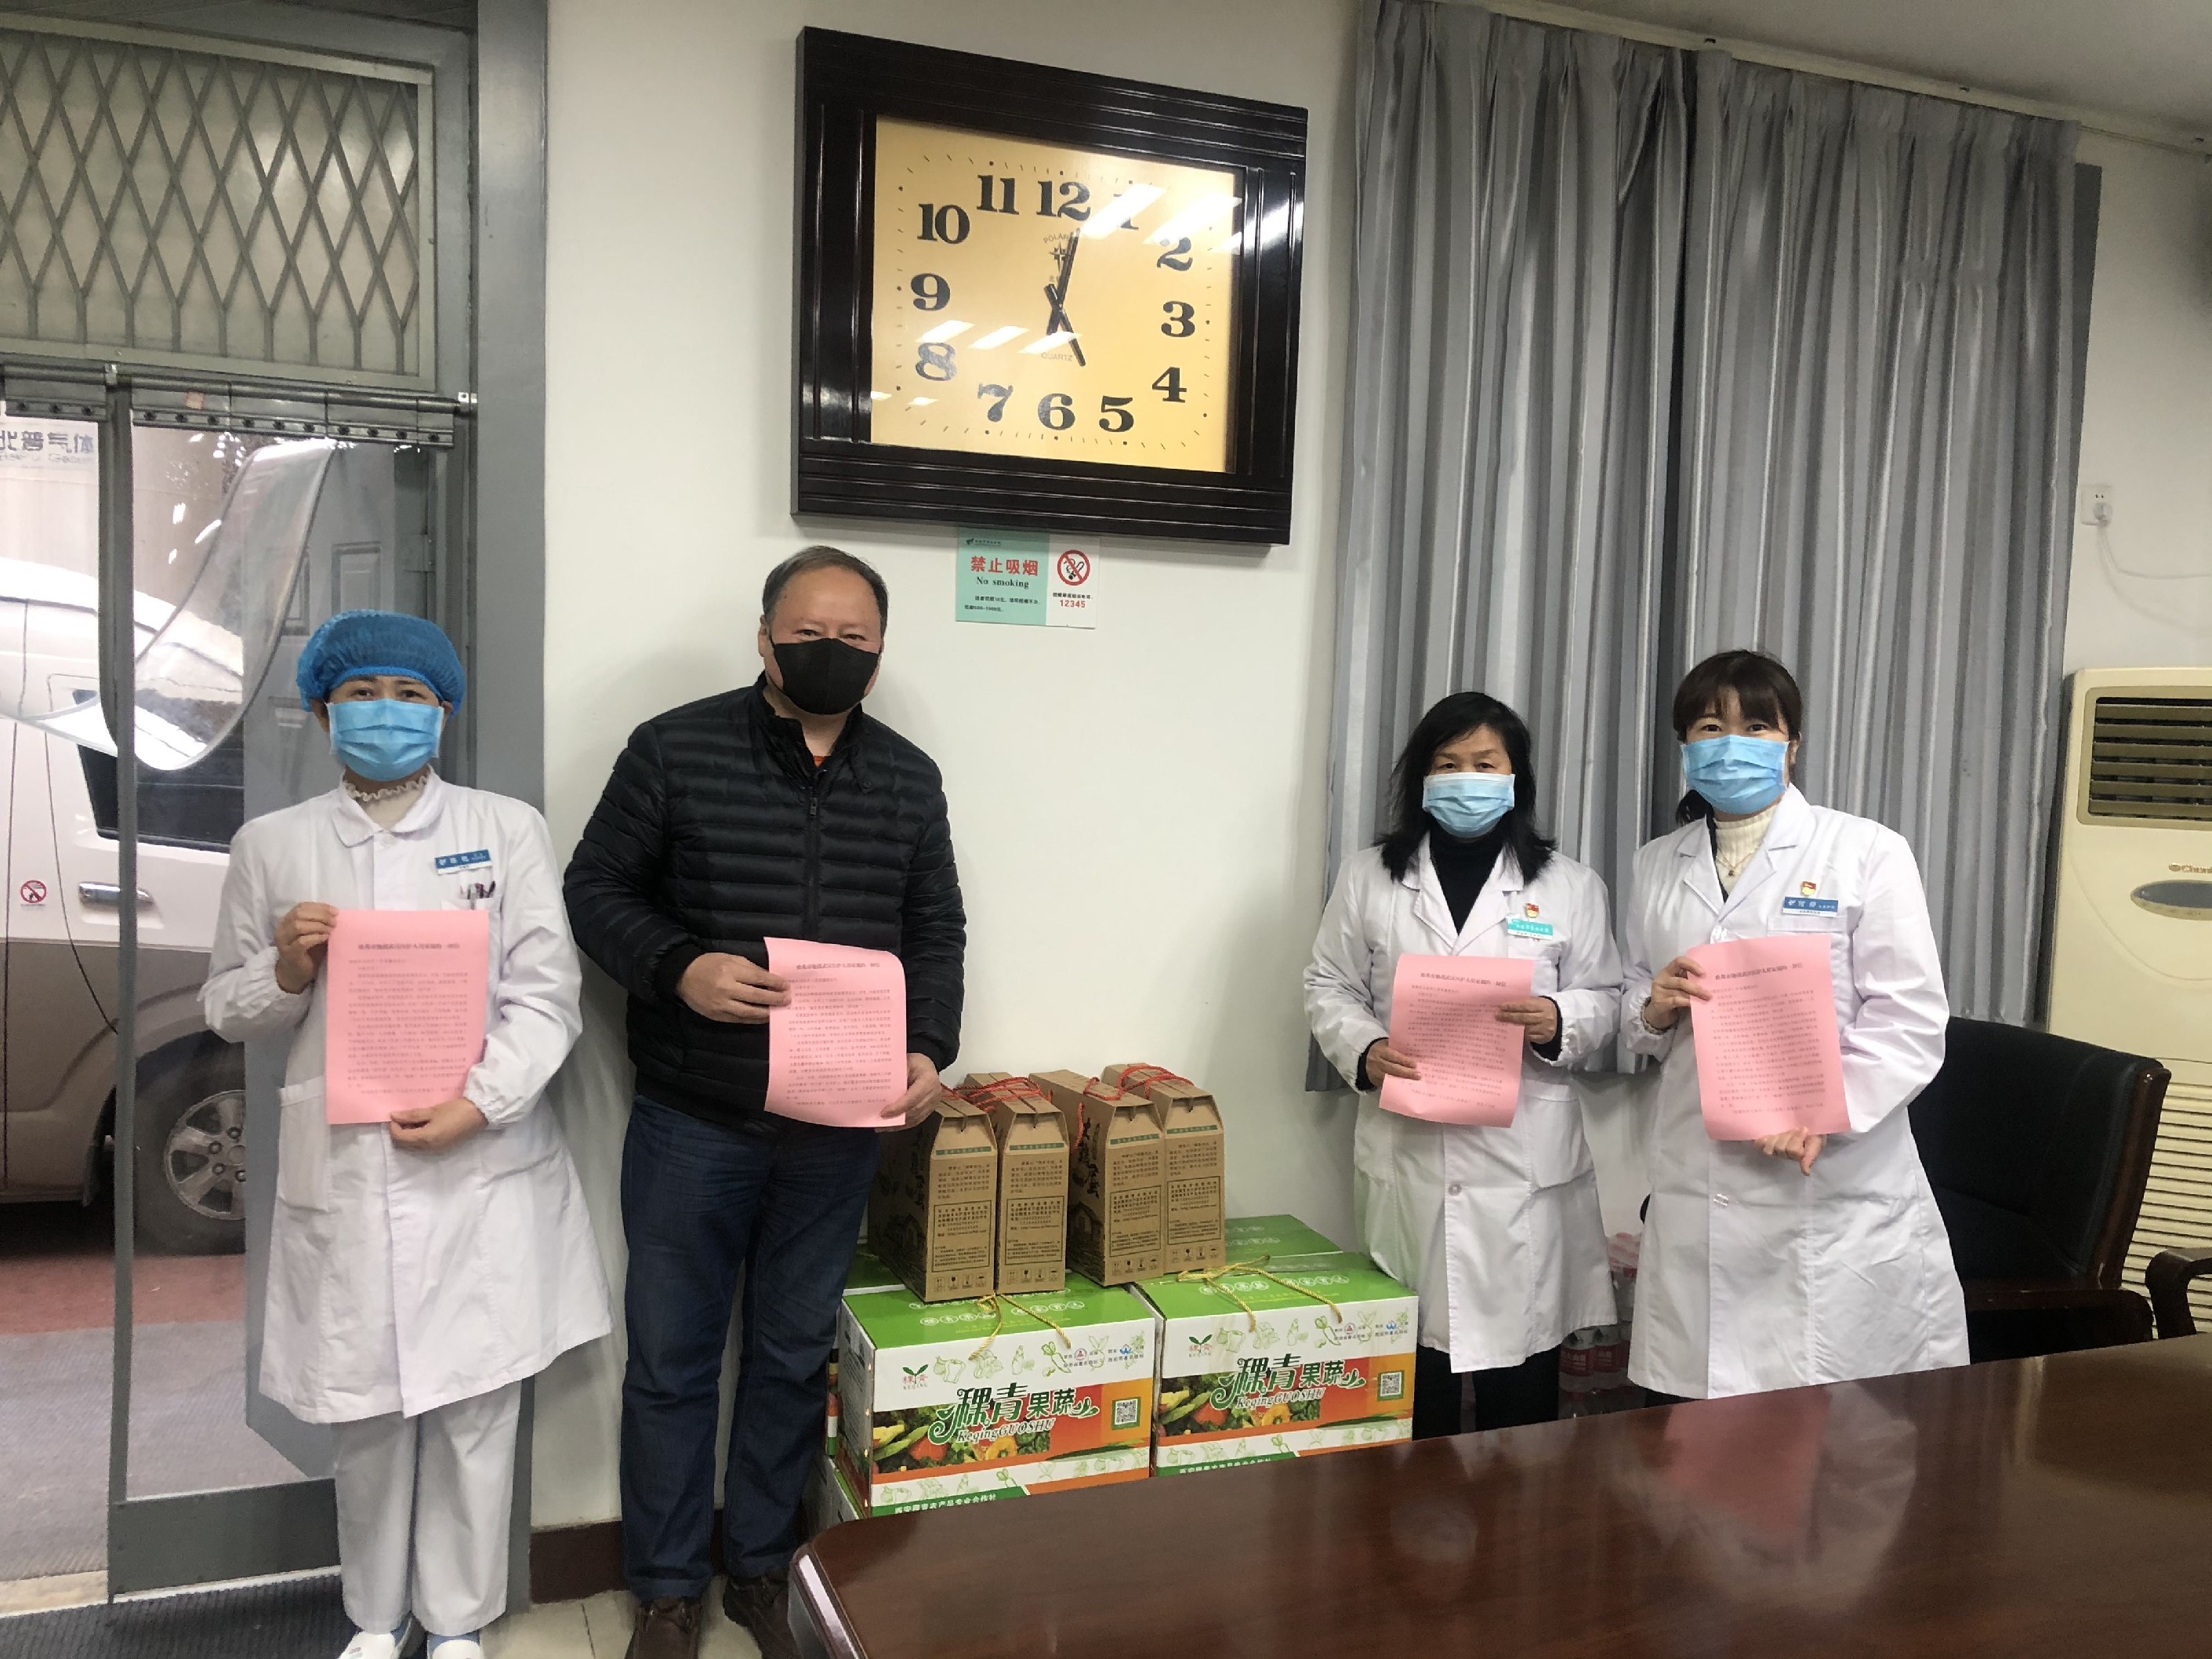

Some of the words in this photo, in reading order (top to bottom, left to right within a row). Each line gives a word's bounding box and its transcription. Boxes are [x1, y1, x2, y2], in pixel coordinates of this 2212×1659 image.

[976, 173, 1019, 216] 11
[1035, 177, 1092, 222] 12
[916, 202, 970, 245] 10
[1156, 235, 1195, 272] 2
[910, 272, 951, 312] 9
[1161, 300, 1195, 338] 3
[915, 341, 957, 382] 8
[976, 383, 1015, 423] 7
[1151, 366, 1188, 404] 4
[1037, 393, 1076, 431] 6
[1098, 395, 1135, 434] 5
[970, 555, 1039, 577] 禁止吸烟
[976, 576, 989, 585] No
[992, 578, 1029, 590] smoking
[1060, 599, 1086, 608] 12345
